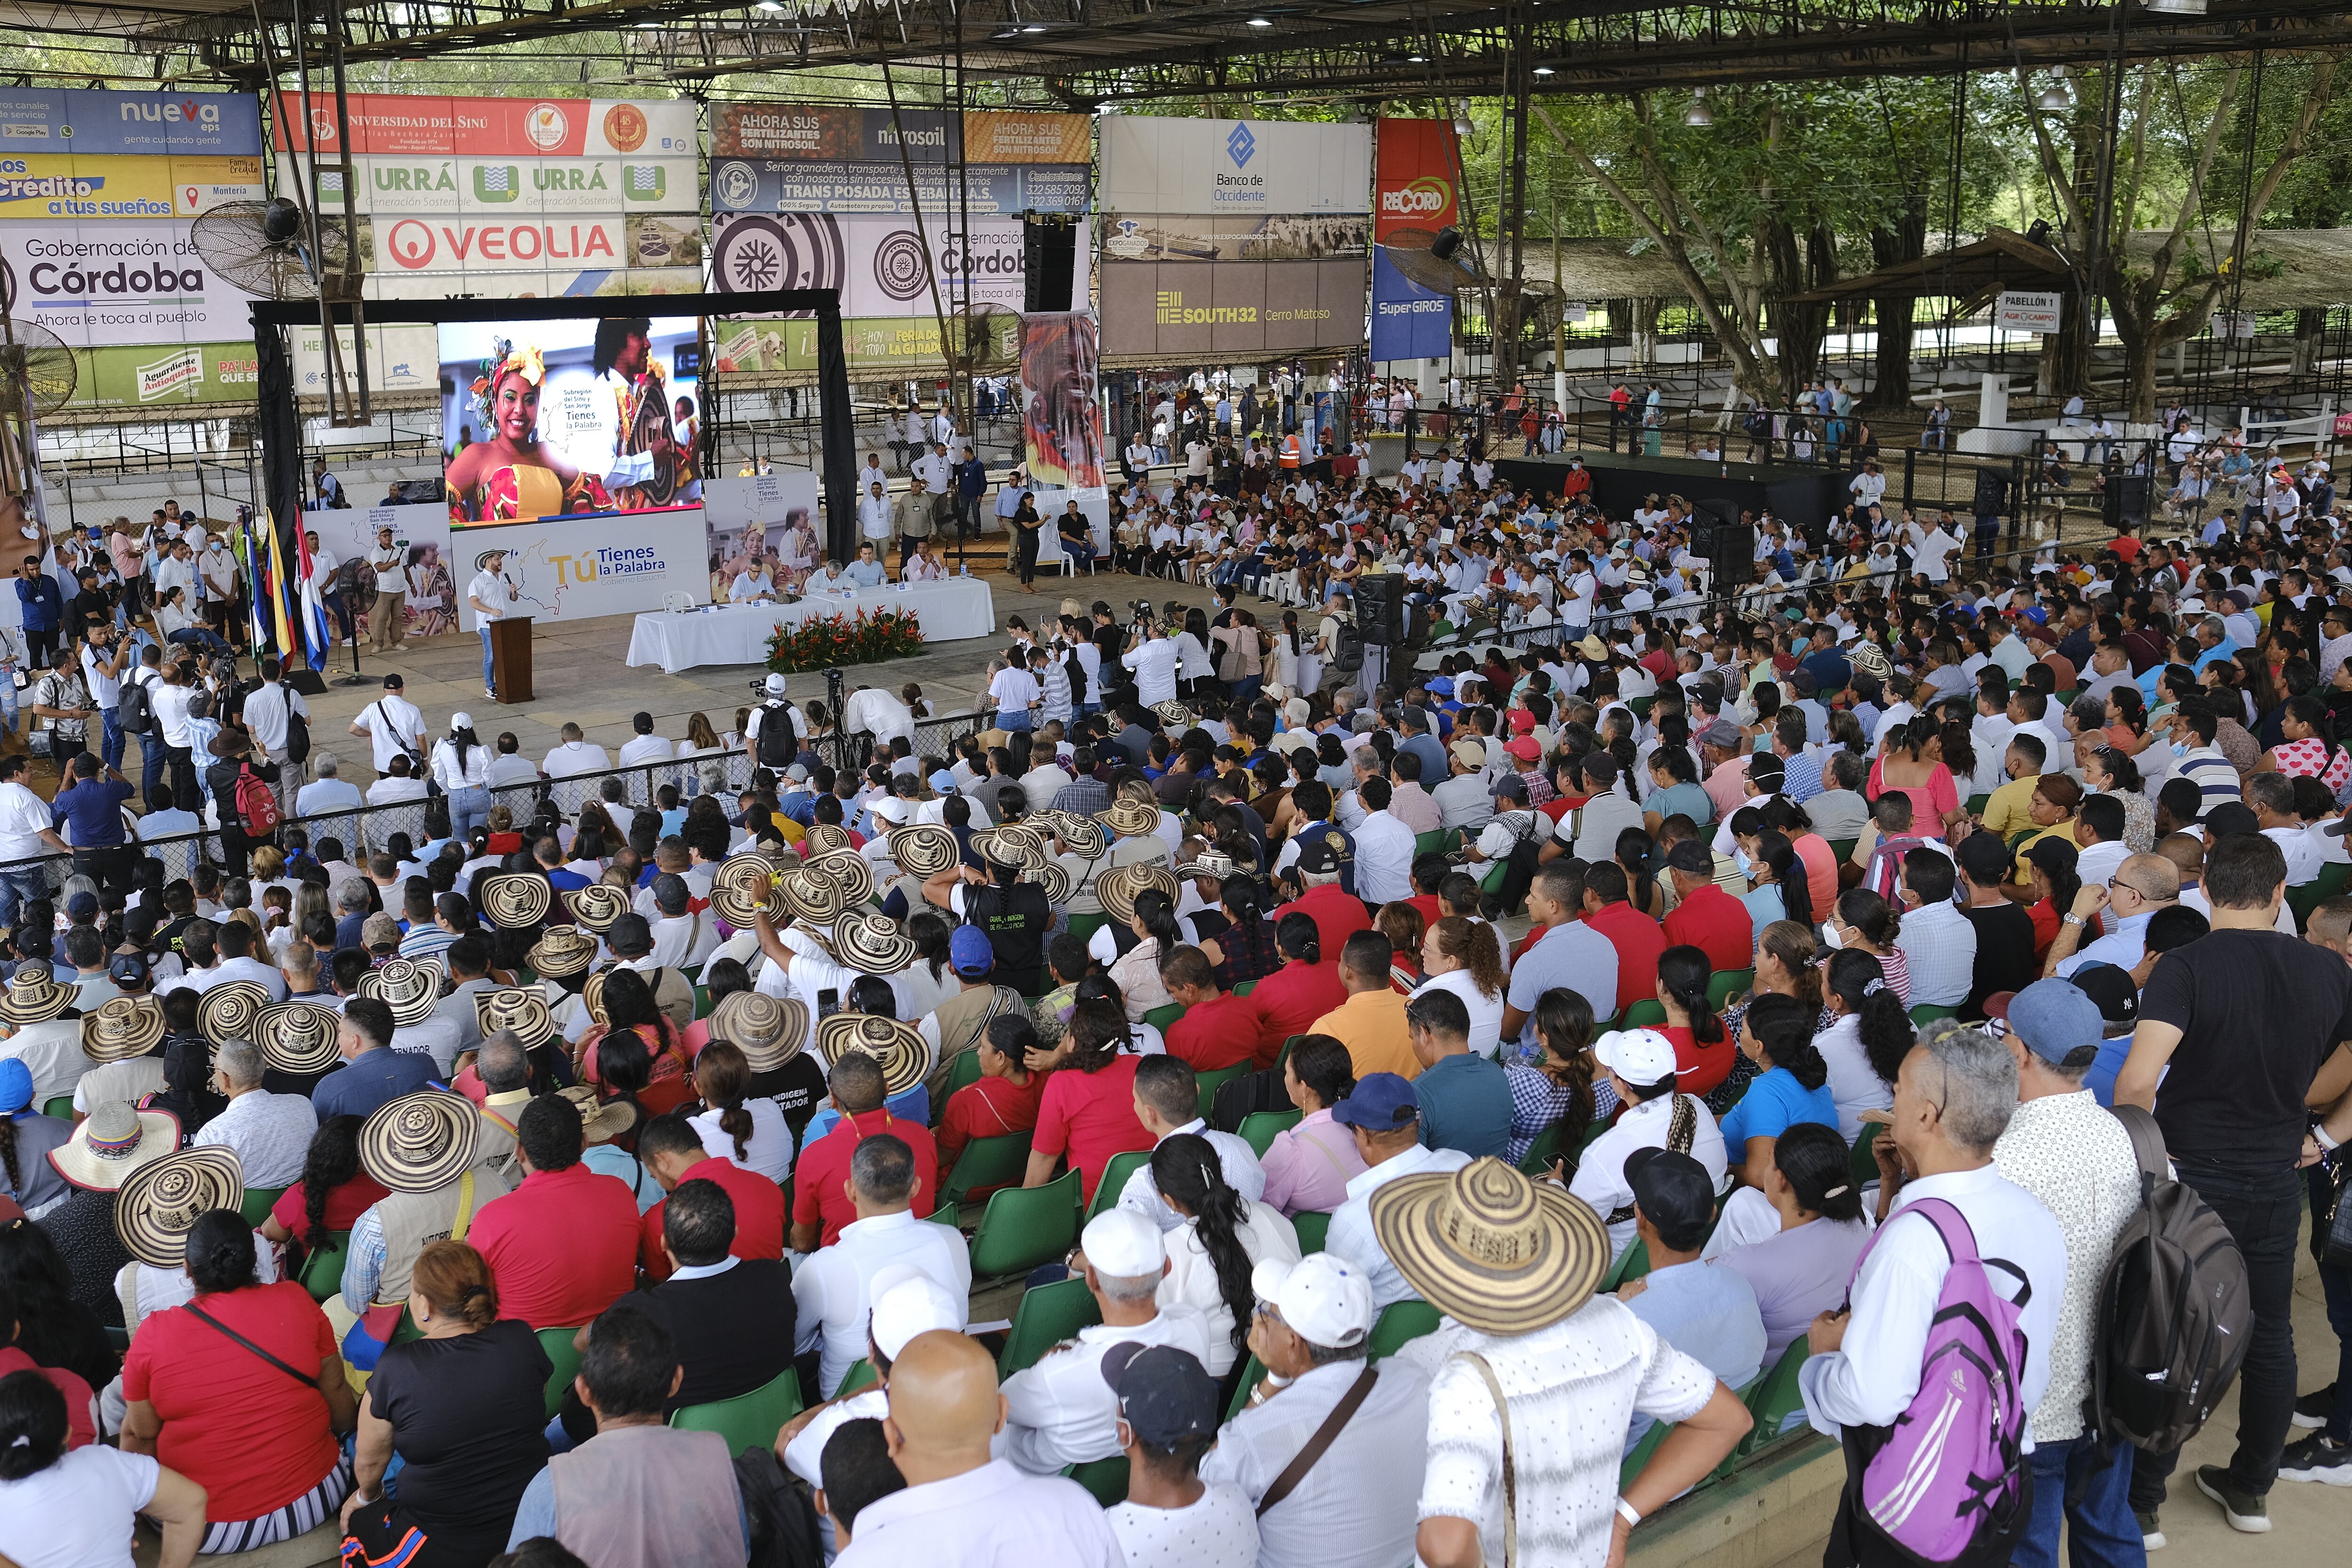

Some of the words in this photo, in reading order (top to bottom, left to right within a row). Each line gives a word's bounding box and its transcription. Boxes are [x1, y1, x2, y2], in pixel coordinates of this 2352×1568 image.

[121, 100, 219, 122] nueva
[350, 116, 427, 127] NIVERSIDAD
[431, 117, 455, 128] DEL
[620, 115, 631, 125] 48
[740, 115, 789, 127] AHORA
[793, 116, 819, 129] SUS
[201, 123, 220, 133] eps
[740, 128, 820, 139] FERTILIZANTES
[993, 123, 1034, 135] AHORA
[1039, 124, 1061, 135] SUS
[153, 135, 194, 144] cuidando
[741, 139, 762, 149] SON
[764, 140, 820, 150] NITROSOIL.
[993, 135, 1062, 144] FERTILIZANTES
[1014, 146, 1062, 154] NITROSOIL.
[765, 161, 795, 172] Señor
[796, 163, 845, 175] ganadero,
[848, 164, 899, 175] transporte
[375, 163, 456, 191] URRÁ
[533, 162, 607, 191] URRÁ
[805, 175, 848, 183] nosotros
[850, 175, 863, 183] sin
[913, 175, 924, 185] de
[1217, 174, 1248, 185] Banco
[1251, 174, 1263, 185] de
[0, 174, 92, 197] Crédito
[213, 186, 246, 195] Montería
[784, 184, 831, 198] TRANS
[834, 185, 891, 198] POSADA
[1026, 185, 1043, 194] 322
[1044, 185, 1062, 194] 585
[1063, 185, 1086, 194] 2092
[526, 196, 577, 206] Generación
[580, 196, 623, 205] Sostenible
[1028, 197, 1045, 206] 322
[1046, 197, 1063, 206] 369
[1065, 196, 1084, 206] 0161
[1214, 189, 1264, 201] Occidente
[1383, 189, 1442, 213] RECORD
[48, 201, 63, 215] a
[66, 199, 97, 215] tus
[101, 199, 171, 215] sueños
[366, 197, 421, 207] Generación
[423, 197, 471, 206] Sostenible
[26, 239, 167, 257] Gobernación
[174, 239, 198, 255] de
[442, 225, 614, 260] VEOLIA
[29, 262, 204, 294] Córdoba
[971, 289, 979, 298] le
[982, 289, 1002, 298] toca
[1005, 288, 1013, 297] al
[2006, 295, 2046, 306] PABELLÓN
[35, 314, 79, 326] Ahora
[85, 313, 96, 325] le
[101, 312, 135, 325] toca
[141, 311, 152, 324] al
[157, 310, 207, 326] pueblo
[1184, 307, 1257, 323] SOUTH32
[1265, 310, 1292, 321] Cerro
[1295, 307, 1330, 320] Matoso
[867, 330, 883, 342] HOY
[865, 344, 885, 356] TODO
[889, 343, 901, 356] LA
[144, 358, 196, 382] Aguardiente
[144, 366, 197, 391] Antioqueño
[220, 373, 245, 383] QUE
[566, 411, 595, 420] Tienes
[597, 546, 655, 562] Tienes
[548, 551, 597, 585] Tú
[599, 564, 611, 575] la
[615, 560, 665, 574] Palabra
[601, 577, 635, 586] Gobierno
[637, 573, 667, 582] Escucha
[772, 1088, 808, 1101] INDIGENA
